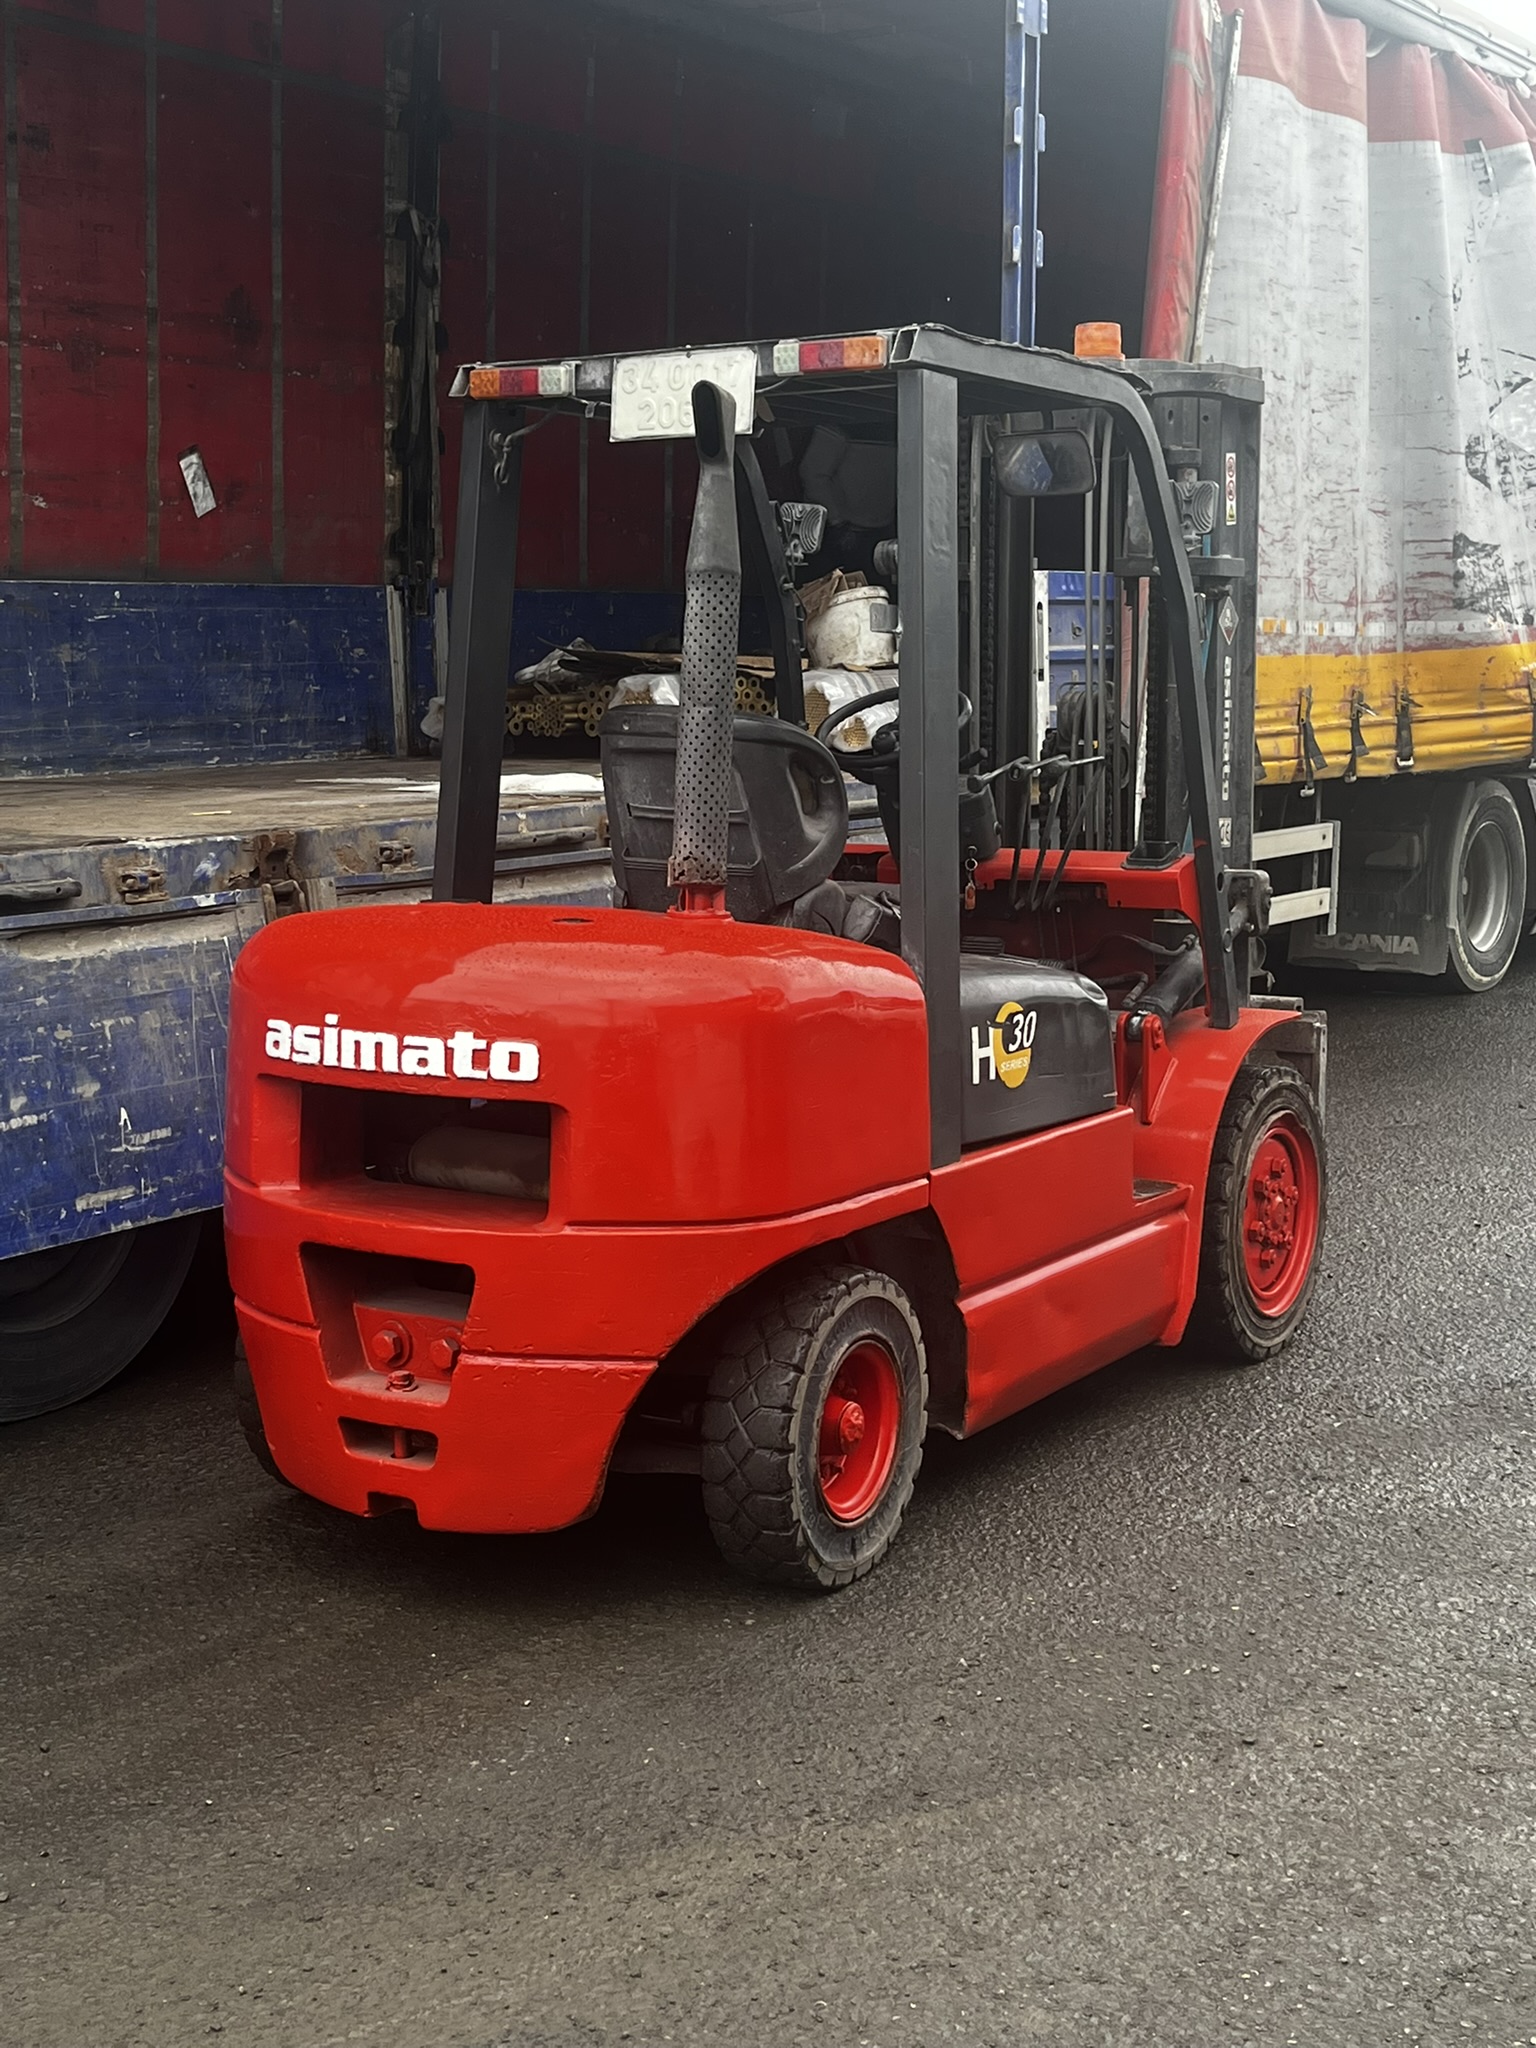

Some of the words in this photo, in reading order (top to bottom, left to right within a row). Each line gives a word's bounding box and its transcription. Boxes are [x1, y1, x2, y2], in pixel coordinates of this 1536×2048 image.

[621, 360, 659, 395] 34
[1313, 932, 1420, 955] SCANIA
[265, 1013, 540, 1082] asimato
[1008, 1011, 1037, 1052] 30
[1000, 1056, 1029, 1073] SERIES
